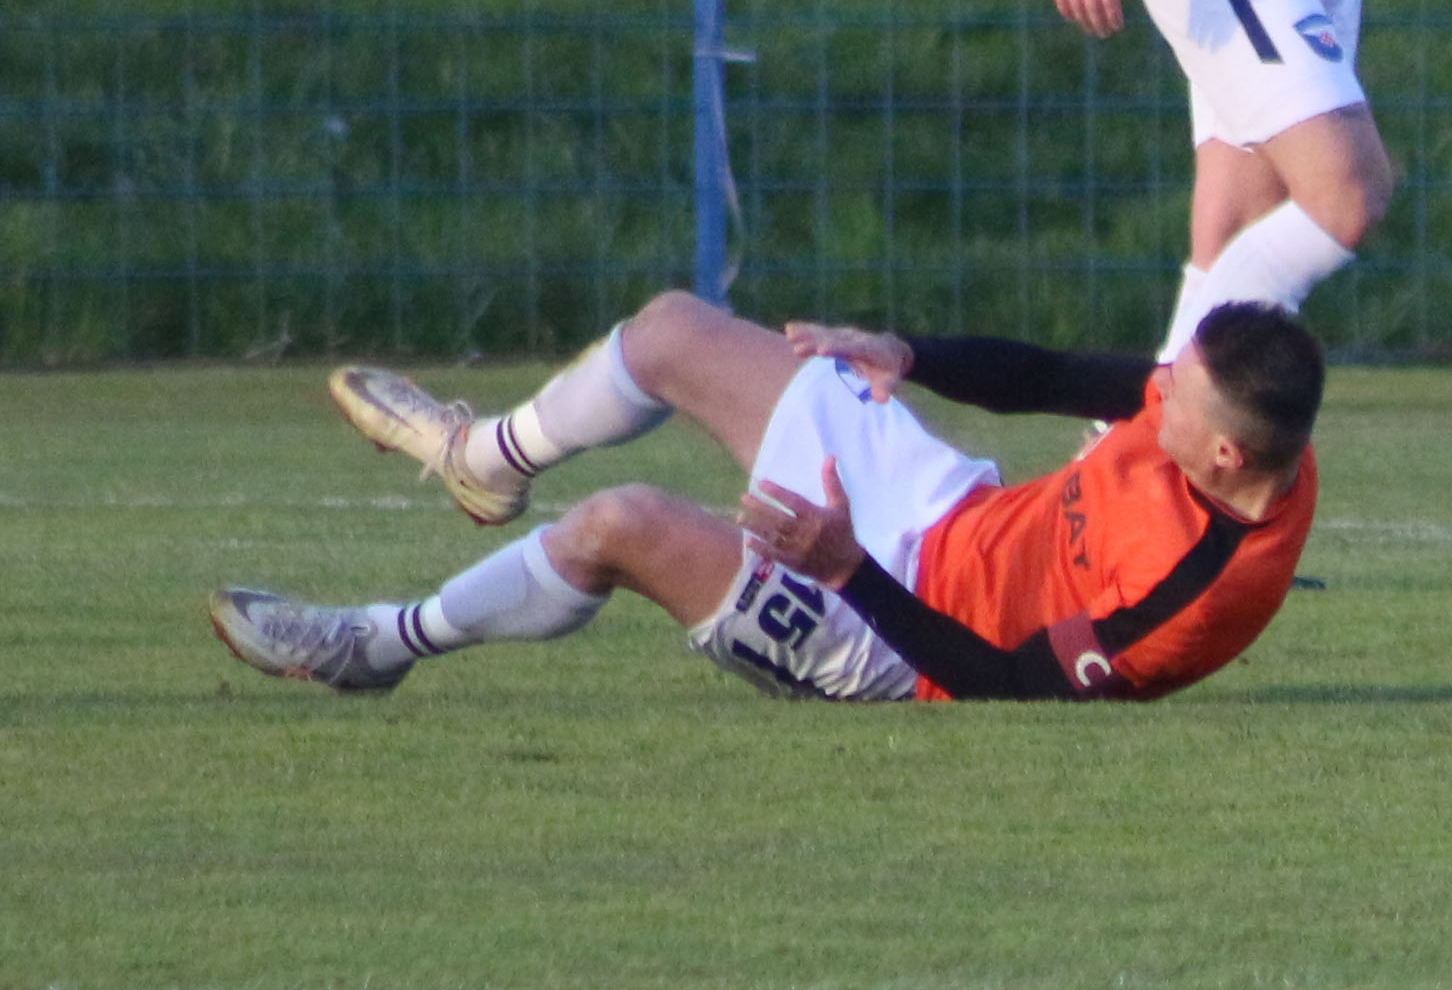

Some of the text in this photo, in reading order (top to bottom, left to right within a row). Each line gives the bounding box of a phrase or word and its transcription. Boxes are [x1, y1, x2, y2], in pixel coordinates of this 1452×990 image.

[1061, 470, 1091, 571] BAT
[758, 573, 826, 651] 15
[1075, 649, 1112, 687] C
